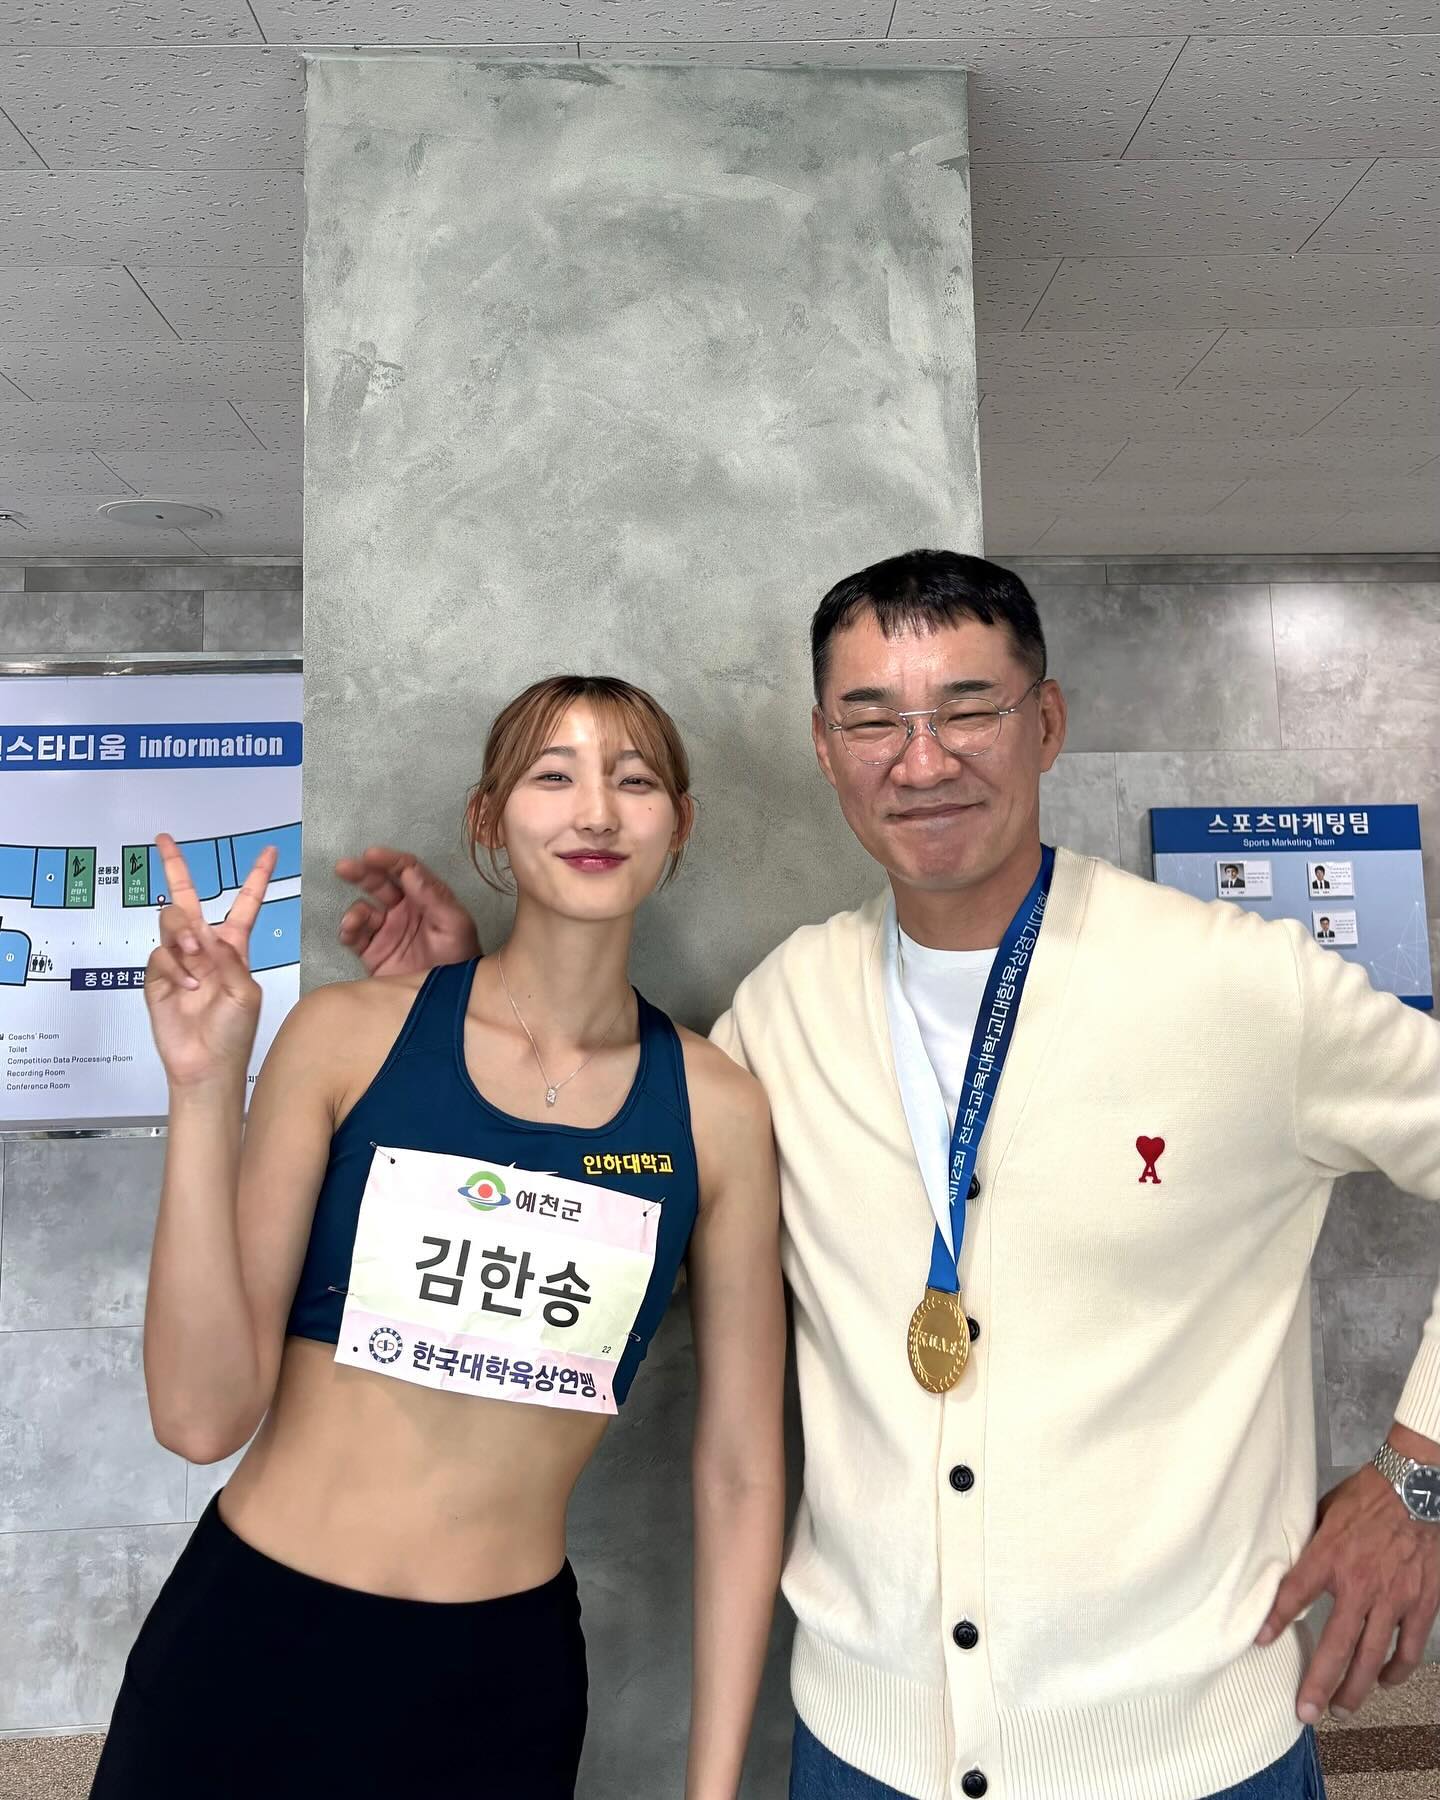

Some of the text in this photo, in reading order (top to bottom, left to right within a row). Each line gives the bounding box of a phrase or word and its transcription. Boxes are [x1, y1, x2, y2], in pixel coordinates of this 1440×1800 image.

[0, 734, 283, 761] 스타디움 information
[1208, 812, 1369, 835] 스포츠마케팅팀
[1243, 837, 1335, 848] Sports Marketing Team
[98, 876, 120, 885] 진입로
[84, 971, 146, 987] 중앙현관
[38, 1032, 60, 1040] Room
[8, 1045, 28, 1053] Toilet
[7, 1054, 133, 1065] Competition Data Processing Room
[6, 1069, 44, 1078] Recording
[6, 1082, 49, 1090] Conference
[583, 1153, 674, 1175] 인하대학교
[515, 1189, 583, 1222] 예천군
[415, 1235, 592, 1328] 김한송
[601, 1345, 612, 1354] 22
[412, 1341, 597, 1398] 한국대학육상연맹
